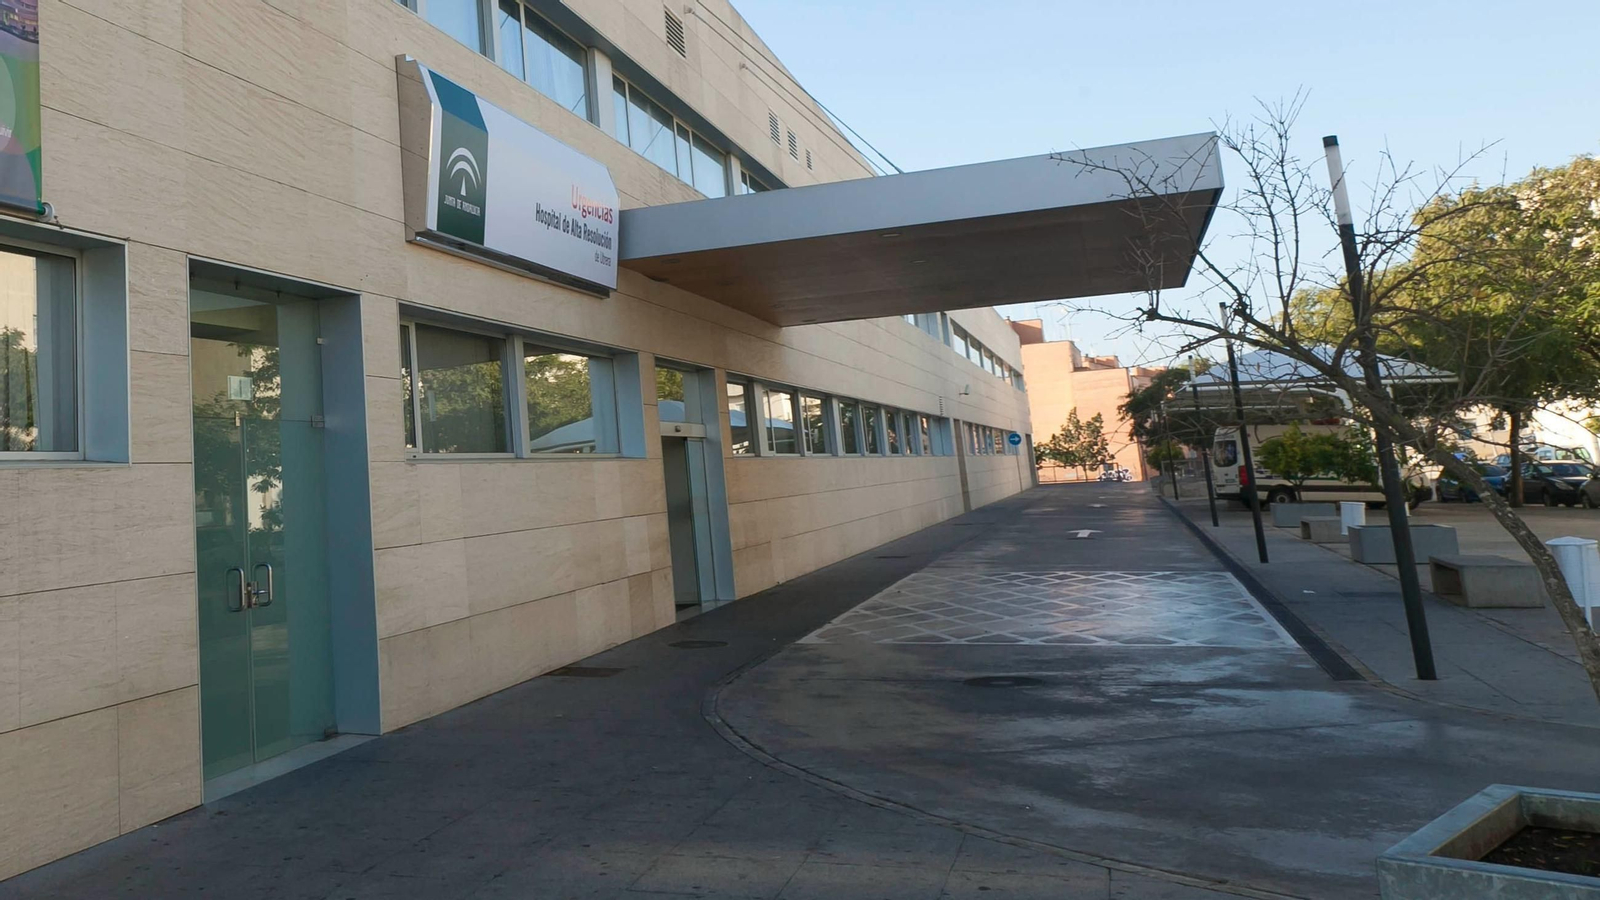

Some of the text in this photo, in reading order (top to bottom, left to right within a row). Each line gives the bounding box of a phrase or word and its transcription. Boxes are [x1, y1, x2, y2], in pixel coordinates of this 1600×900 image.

[444, 194, 456, 207] JUNTA
[456, 198, 462, 210] DE
[571, 184, 614, 224] Urgencias
[535, 202, 612, 250] Hospital de Alta Resolución
[594, 248, 600, 263] de
